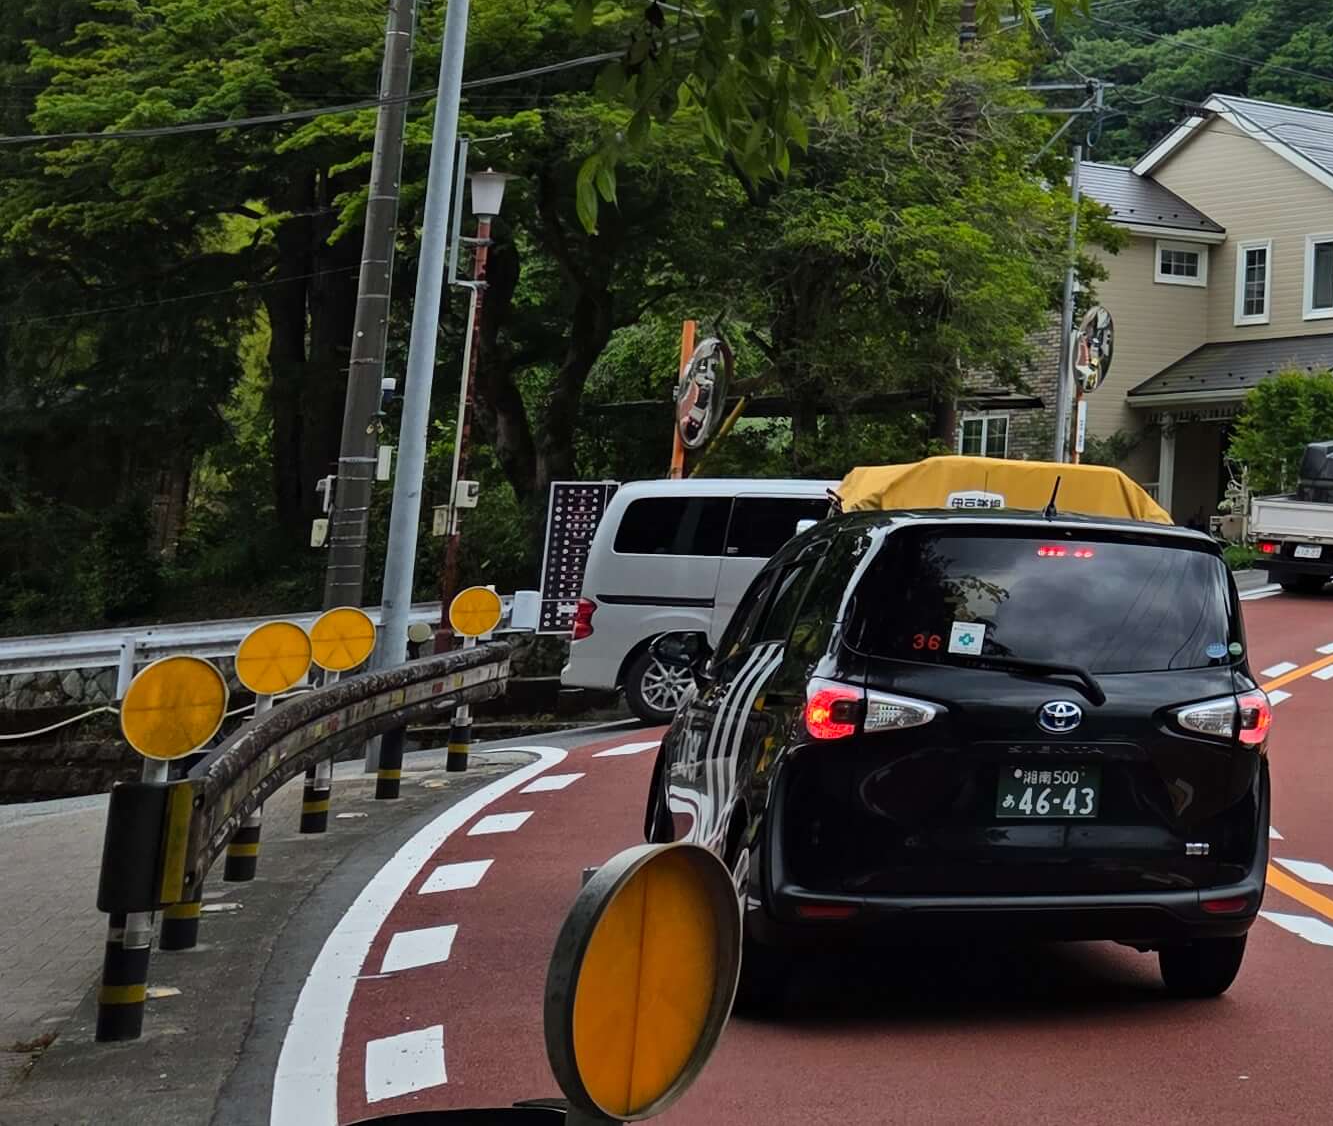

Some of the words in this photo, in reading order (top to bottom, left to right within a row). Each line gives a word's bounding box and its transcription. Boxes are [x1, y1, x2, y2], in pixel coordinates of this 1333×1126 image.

[912, 633, 942, 651] 36
[1023, 770, 1079, 785] 湘南500
[1002, 793, 1015, 809] あ
[1018, 787, 1095, 815] 46-43
